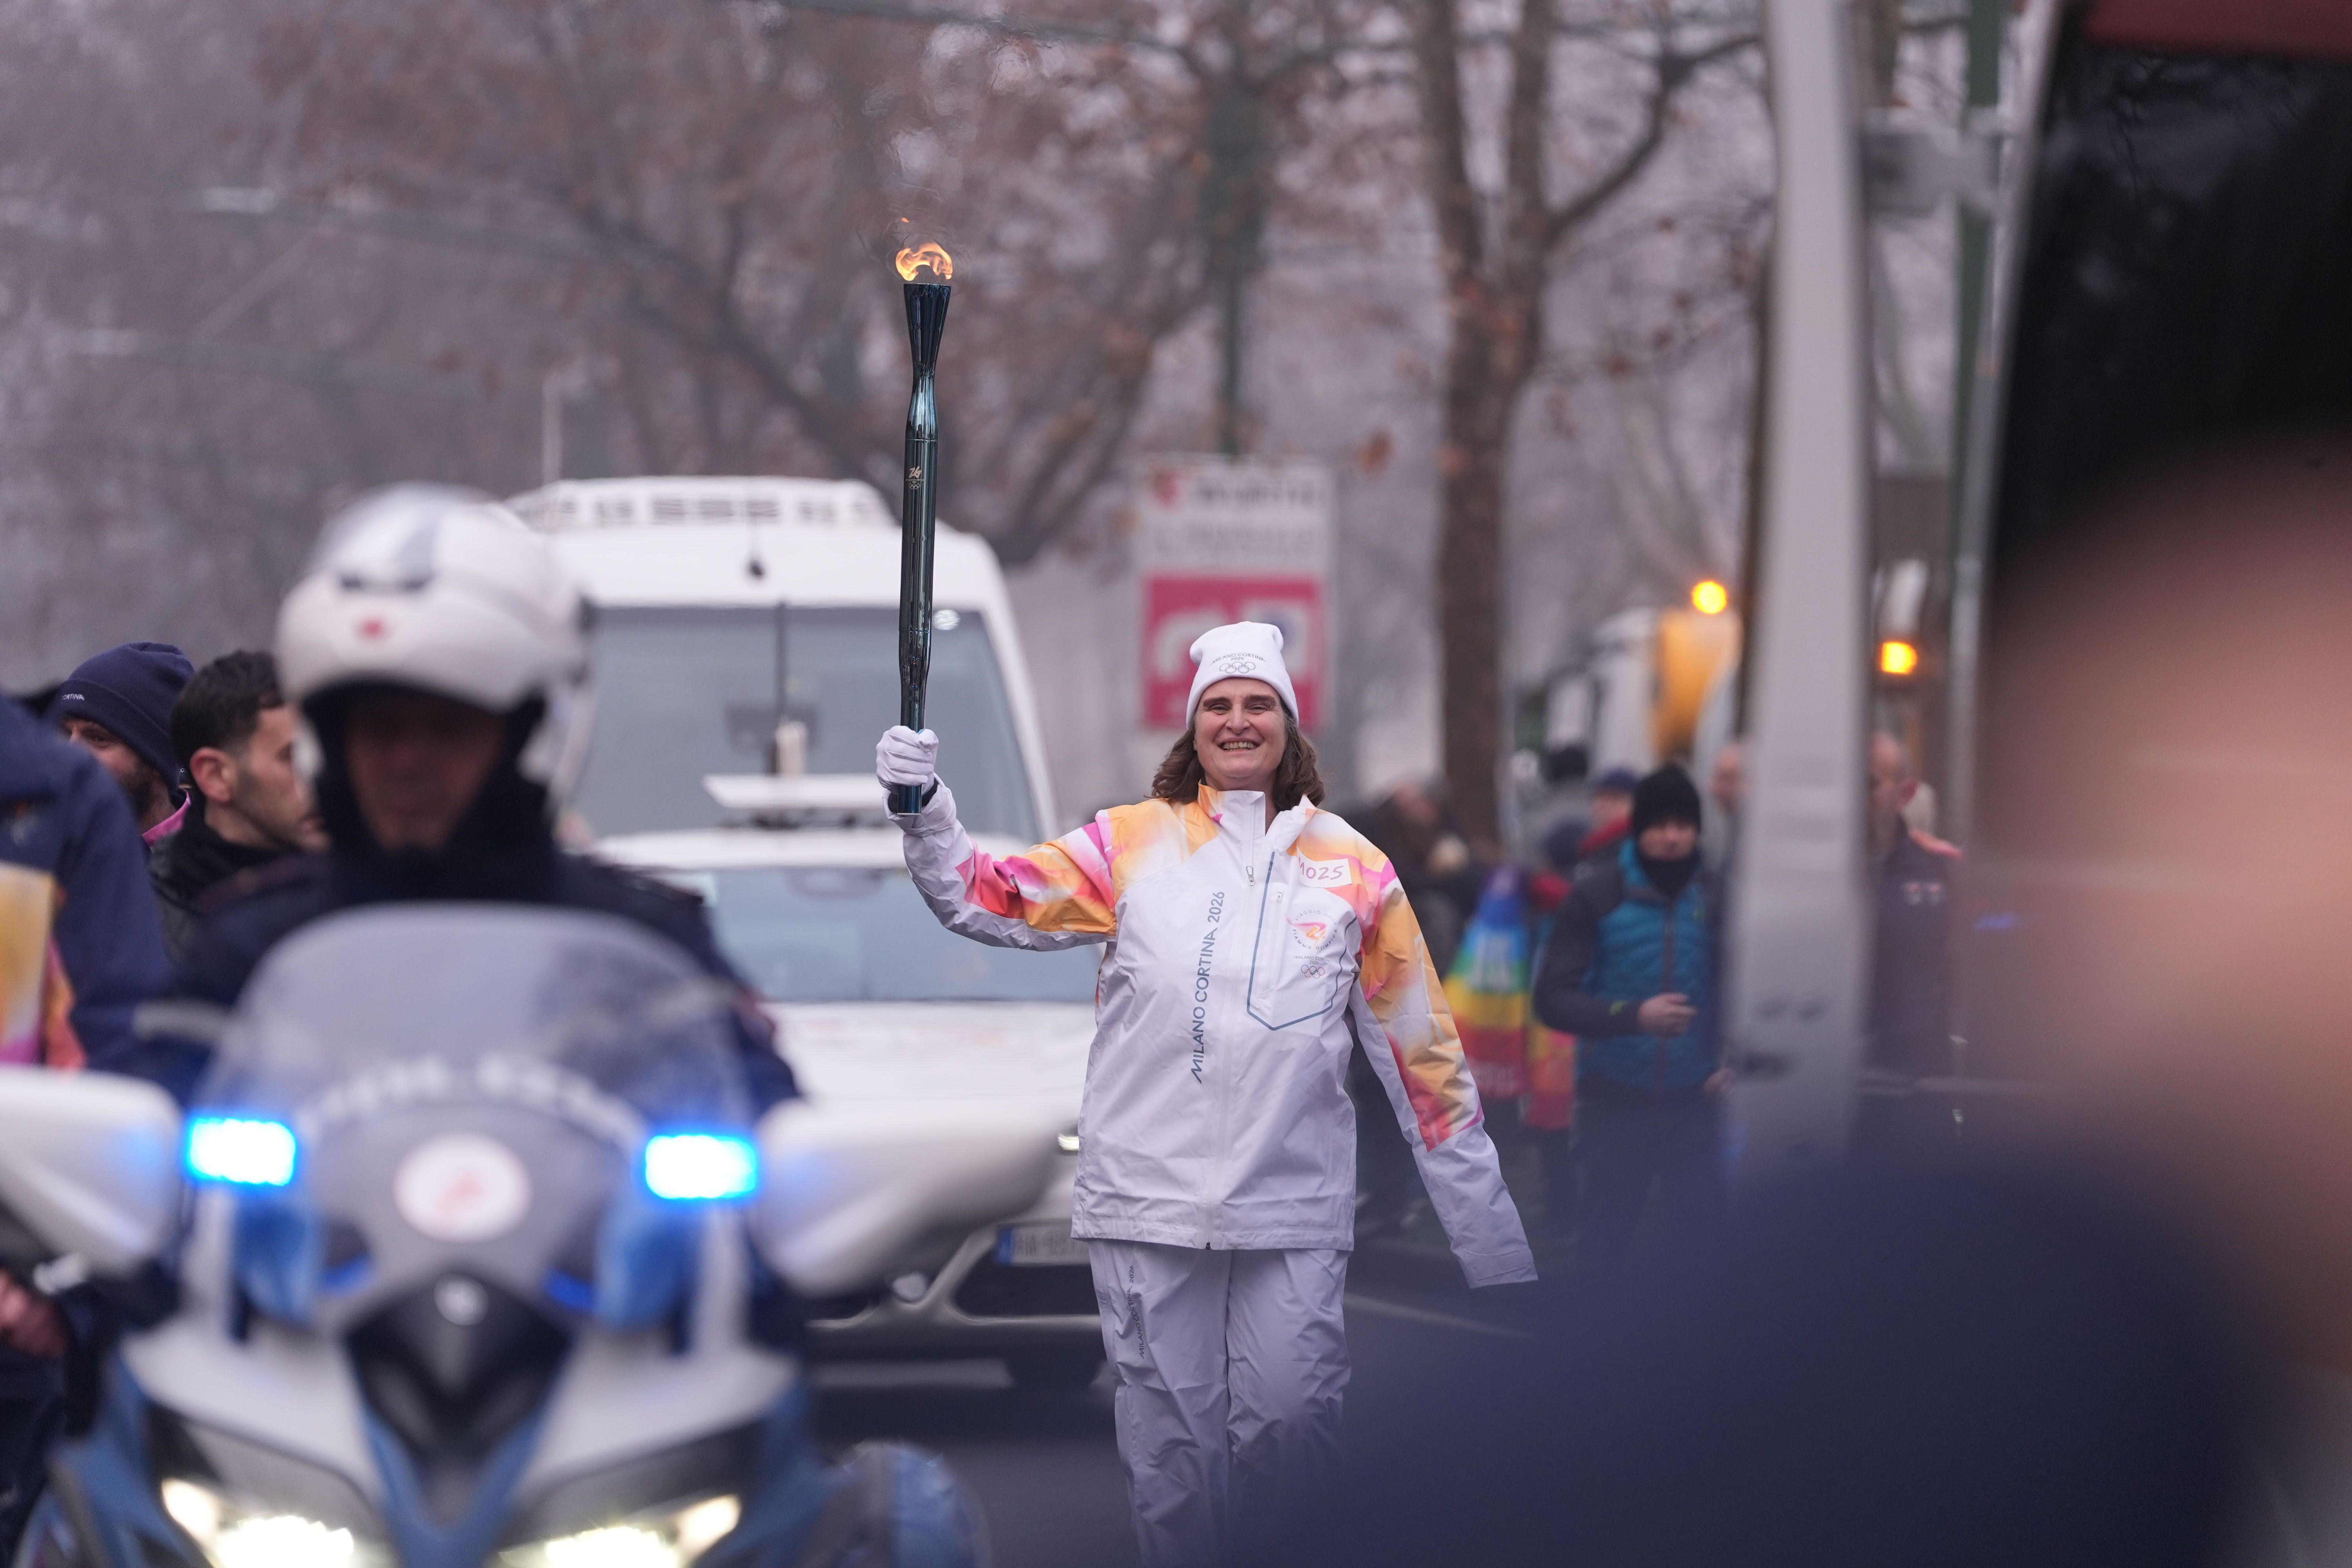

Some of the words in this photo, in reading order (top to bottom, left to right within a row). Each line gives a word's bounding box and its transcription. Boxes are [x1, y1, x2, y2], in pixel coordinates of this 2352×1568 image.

[1210, 653, 1236, 666] MILANO
[1238, 653, 1266, 662] CORTINA
[1207, 892, 1225, 923] 2026
[1295, 909, 1320, 921] VIAGGIO
[1292, 929, 1311, 949] FIAMMA
[1316, 929, 1337, 950] OLIMPICA
[1195, 927, 1218, 1002] CORTINA
[1191, 1006, 1205, 1084] MILANO
[1127, 1286, 1139, 1321] CORTINA
[1136, 1323, 1144, 1359] MILANO
